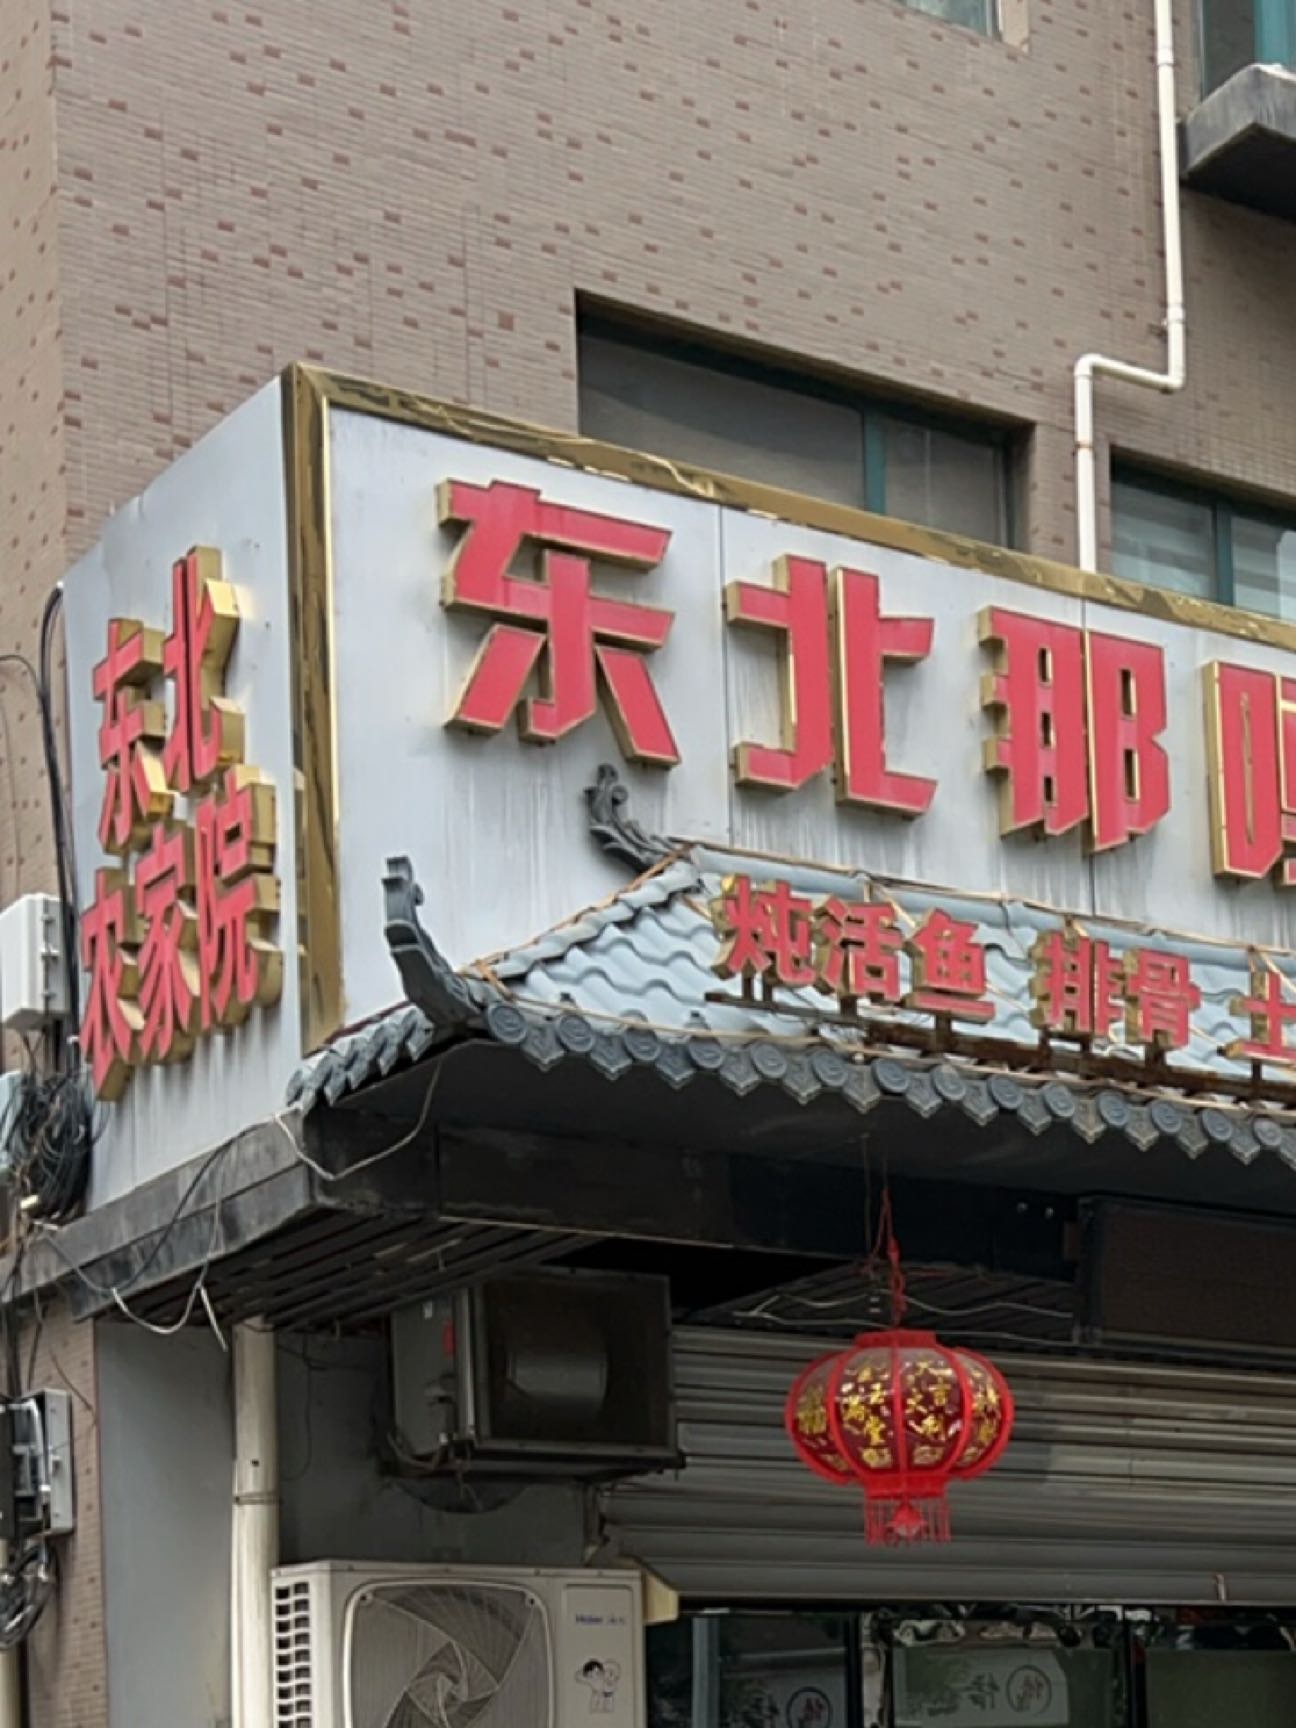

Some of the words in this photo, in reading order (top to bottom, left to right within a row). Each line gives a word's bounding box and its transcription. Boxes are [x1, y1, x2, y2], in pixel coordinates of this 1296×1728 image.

[93, 546, 243, 856] 东北
[80, 766, 283, 1101] 农家院
[711, 873, 995, 1024] 炖活鱼
[1029, 930, 1200, 1050] 排骨
